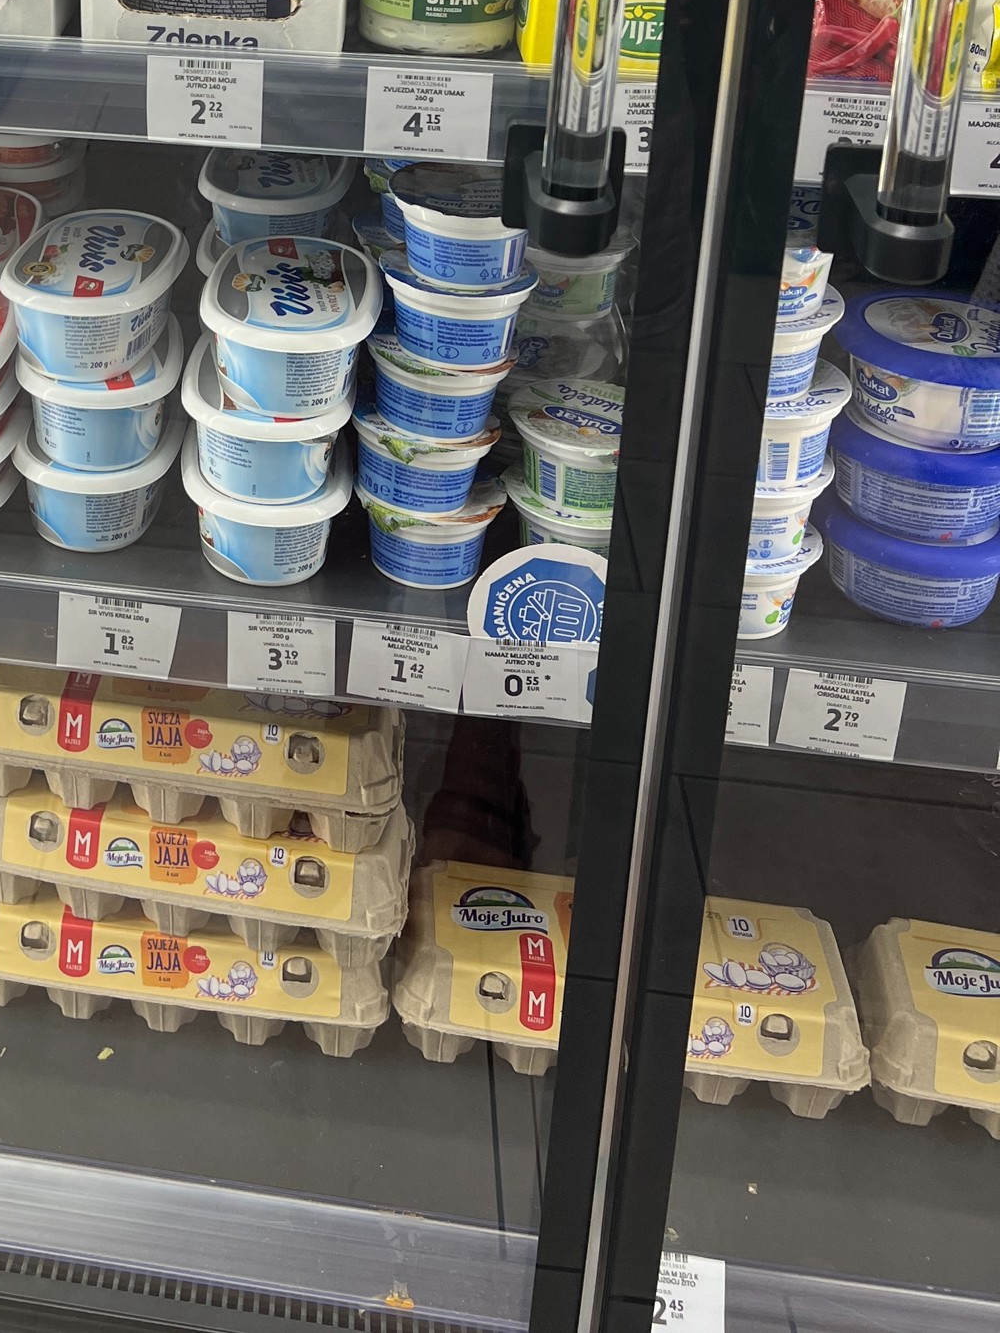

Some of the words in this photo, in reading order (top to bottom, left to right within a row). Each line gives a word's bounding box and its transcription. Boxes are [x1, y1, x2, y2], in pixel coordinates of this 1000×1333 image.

[383, 86, 416, 94] ZVIJEZDA
[416, 88, 443, 96] TARTAR
[444, 89, 465, 97] UMAK
[190, 99, 206, 124] 2
[209, 101, 222, 112] 22
[403, 112, 423, 137] 4
[426, 114, 441, 124] 15
[78, 225, 126, 273] Vivis
[269, 262, 315, 317] Vivis
[859, 372, 890, 398] Dukat
[555, 408, 617, 434] Dukat
[104, 632, 119, 655] 1
[121, 635, 134, 645] 82
[381, 635, 405, 645] NAMAZ
[406, 638, 439, 650] DUKATELA
[268, 648, 283, 670] 3
[285, 650, 299, 660] 19
[485, 650, 508, 659] NAMAZ
[390, 660, 407, 683] 1
[410, 664, 425, 674] 42
[504, 674, 523, 697] 0
[525, 676, 540, 686] 55
[814, 684, 839, 694] NAMAZ
[840, 687, 875, 698] DUKATELA
[65, 712, 83, 738] M
[266, 724, 278, 736] 10
[823, 708, 842, 732] 2
[844, 711, 859, 722] 79
[147, 727, 183, 747] JAJA
[73, 830, 92, 856] M
[155, 831, 188, 846] SVJEŽA
[154, 847, 190, 866] JAJA
[273, 847, 285, 859] 10
[458, 909, 499, 926] Moje
[500, 909, 545, 927] Jutro
[732, 918, 749, 932] 10
[66, 939, 84, 964] M
[147, 937, 180, 952] SVJEŽA
[527, 937, 545, 957] M
[146, 952, 181, 971] JAJA
[933, 970, 977, 991] Moje
[528, 990, 546, 1018] M
[740, 1005, 751, 1018] 10
[652, 1296, 667, 1325] 2
[669, 1299, 684, 1312] 45
